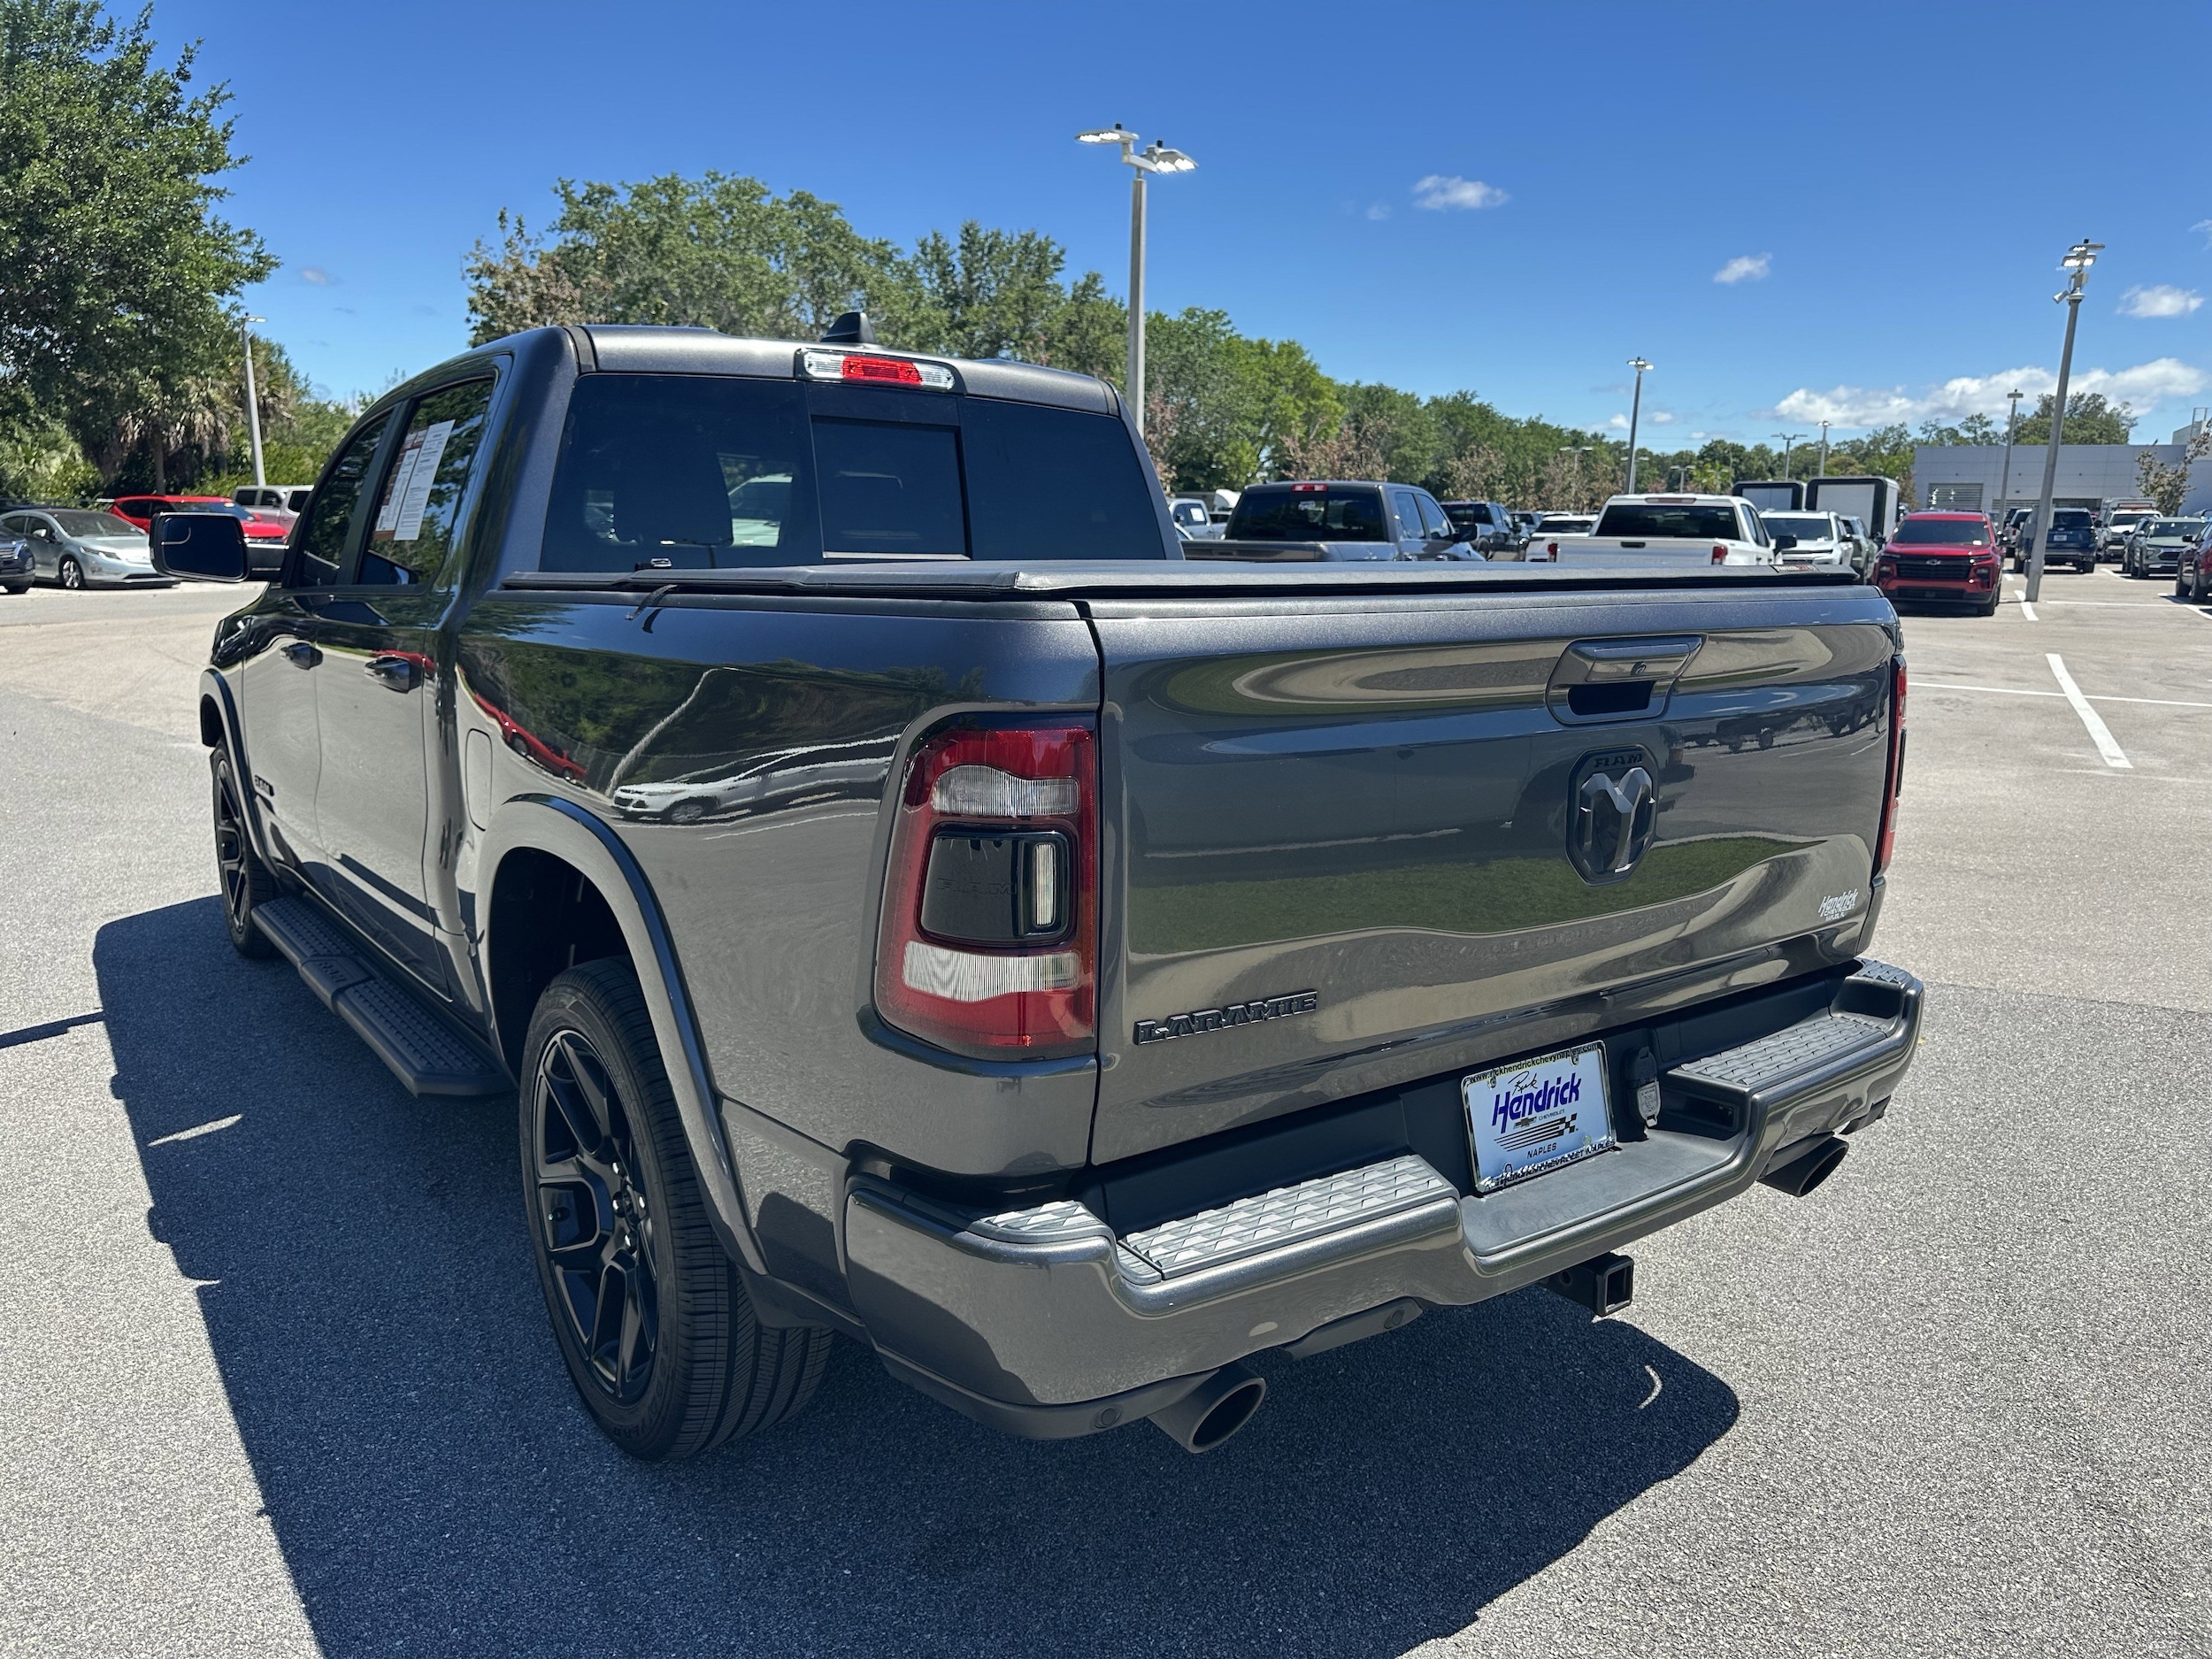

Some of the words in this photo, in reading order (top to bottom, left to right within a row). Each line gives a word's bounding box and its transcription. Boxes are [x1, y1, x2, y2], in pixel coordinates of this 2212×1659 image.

[1594, 753, 1643, 768] RAM
[1818, 888, 1858, 918] Hendrick
[1133, 988, 1317, 1045] LARAMIE
[1492, 1072, 1582, 1133] Hendrick
[1526, 1142, 1557, 1159] NAPLES
